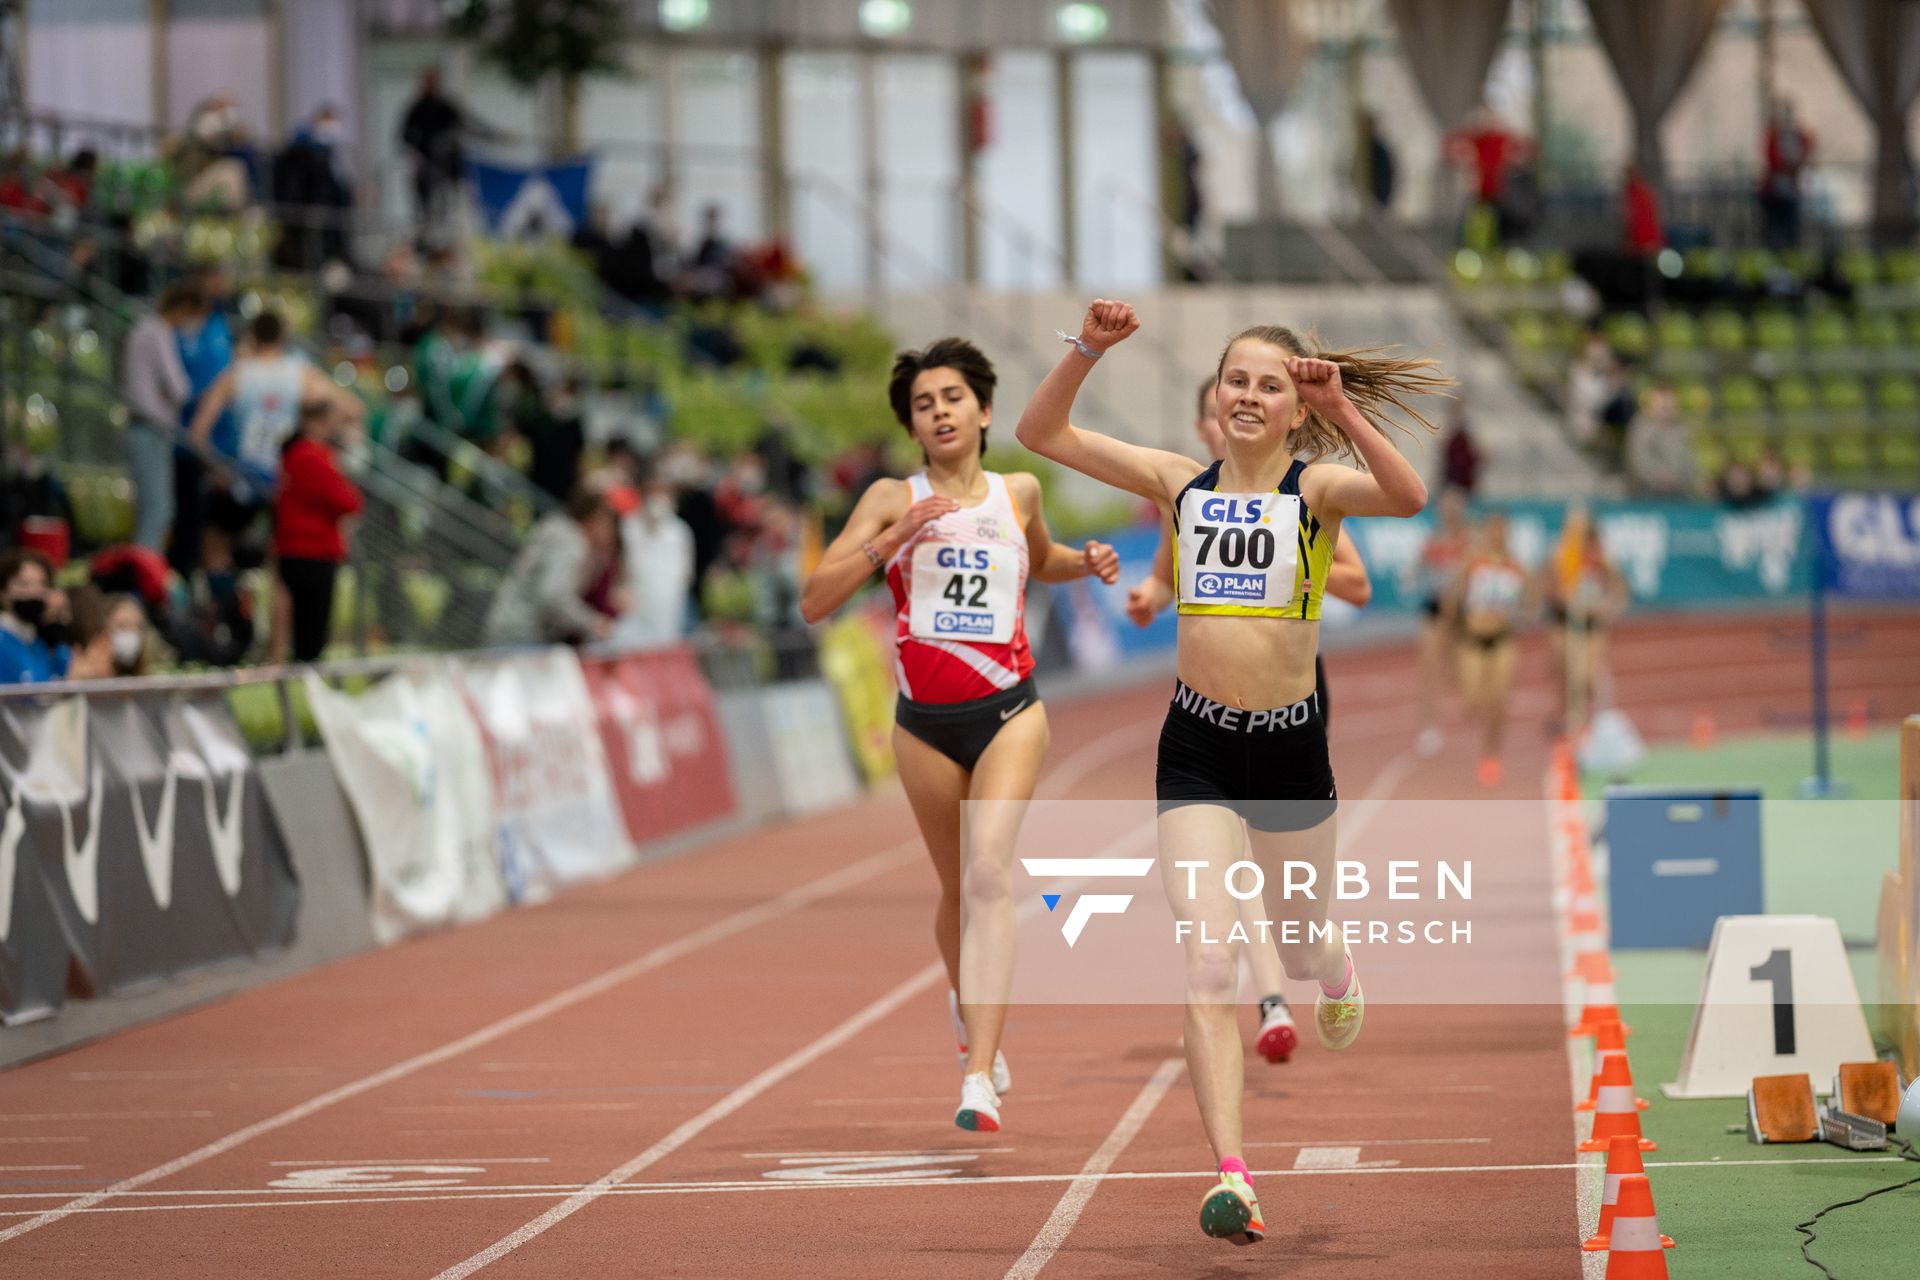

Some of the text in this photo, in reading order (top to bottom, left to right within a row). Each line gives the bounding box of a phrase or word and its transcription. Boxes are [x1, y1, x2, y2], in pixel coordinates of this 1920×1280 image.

[1193, 525, 1275, 569] 700
[943, 574, 988, 608] 42
[1224, 577, 1263, 591] PLAN
[1175, 684, 1243, 731] NIKE
[1246, 701, 1309, 733] PRO
[1750, 949, 1796, 1055] 1
